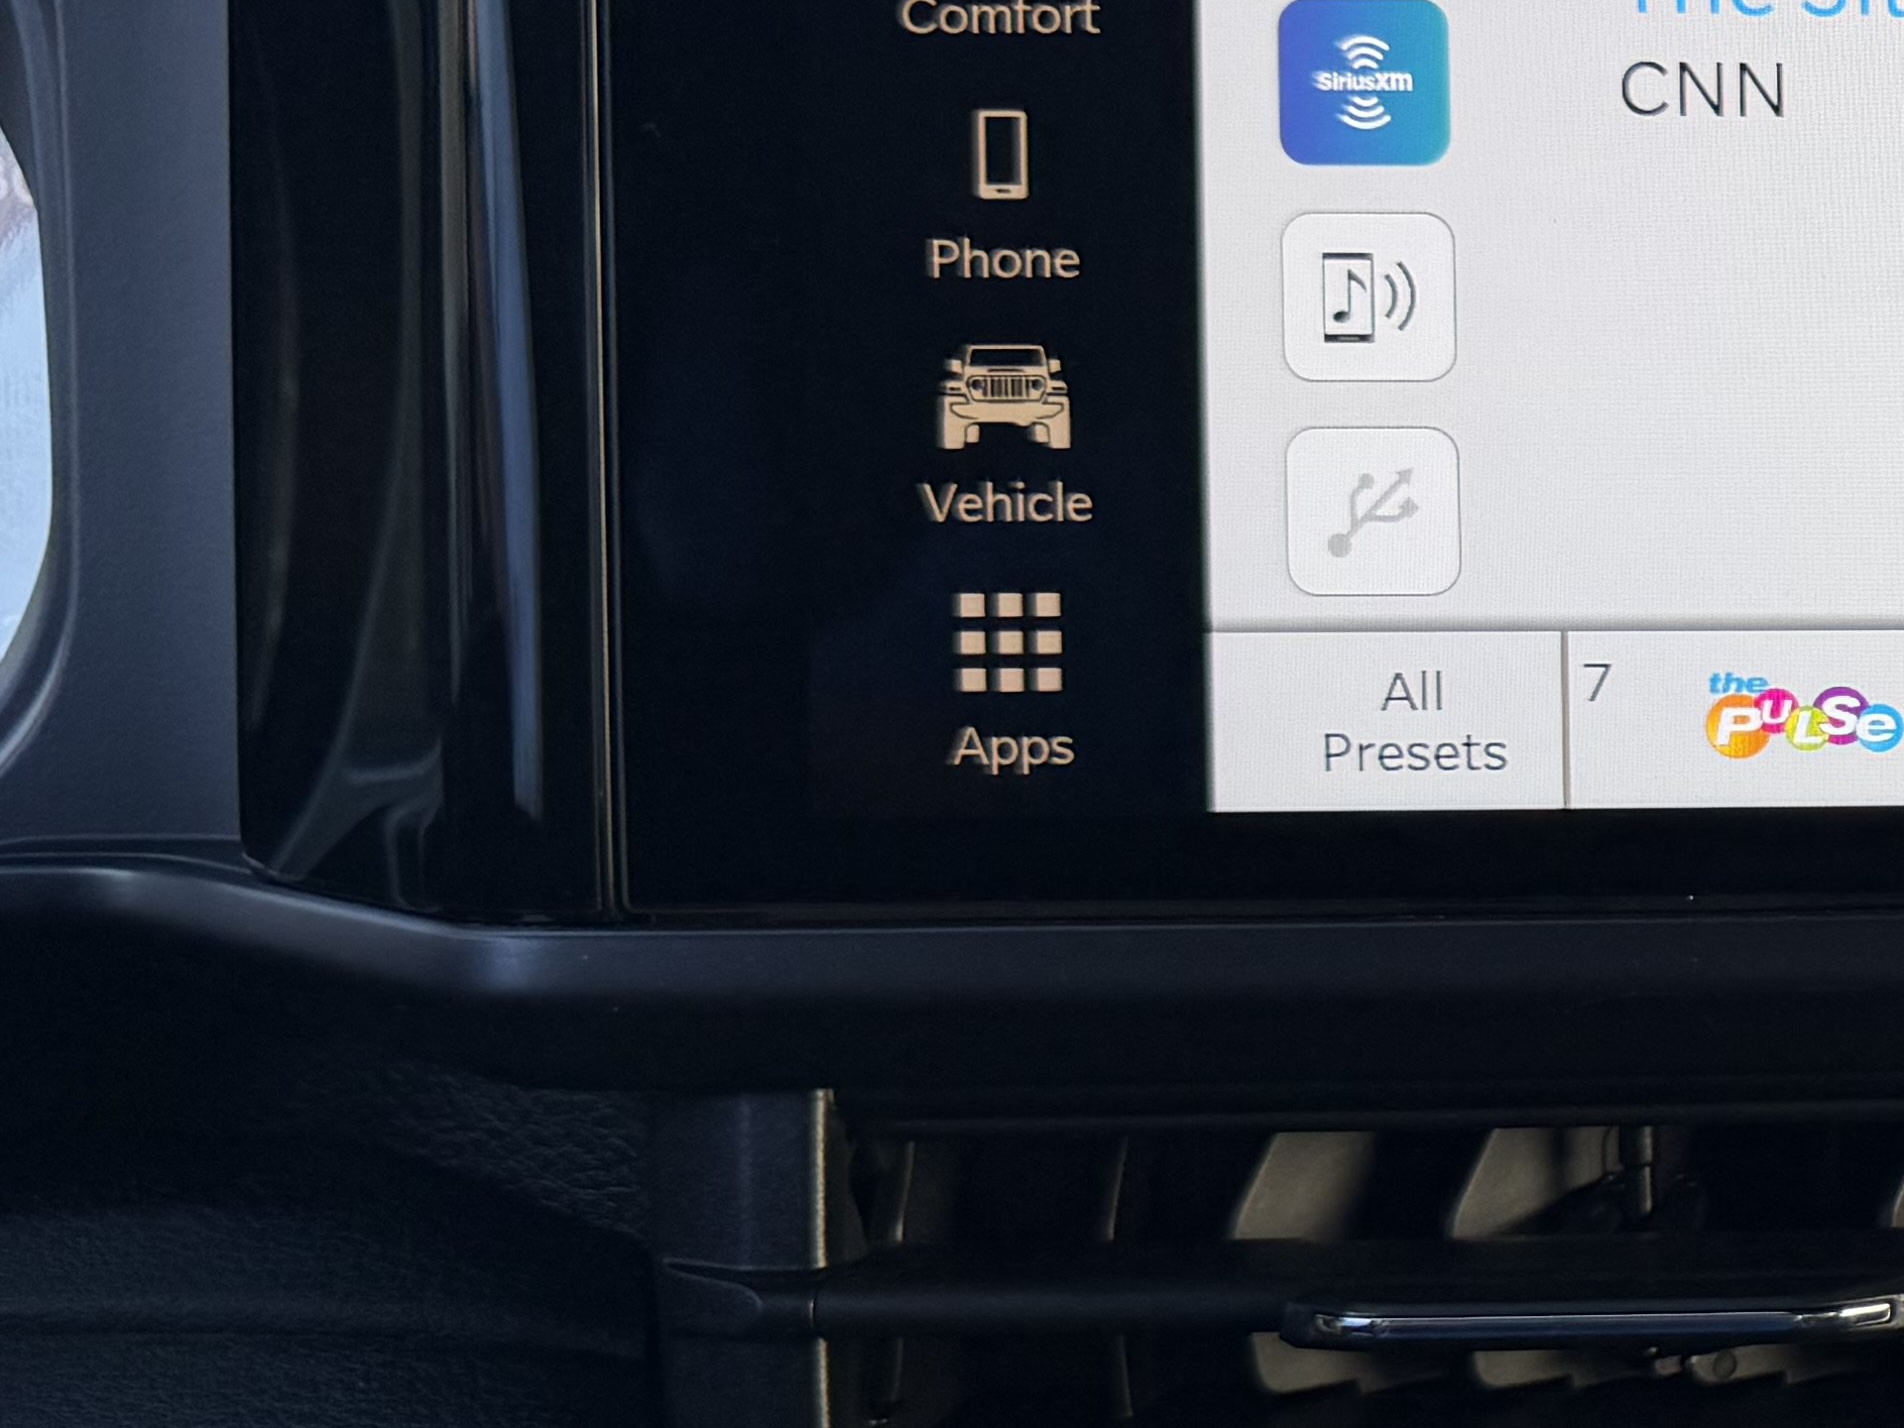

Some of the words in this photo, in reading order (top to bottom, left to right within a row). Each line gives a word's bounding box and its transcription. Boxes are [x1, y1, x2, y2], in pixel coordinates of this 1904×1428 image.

[1621, 60, 1784, 117] CNN
[927, 237, 1080, 279] Phone
[919, 482, 1093, 524] Vehicle
[1380, 671, 1444, 712] All
[1584, 663, 1612, 702] 7
[1709, 672, 1769, 696] the
[949, 727, 1075, 775] Apps
[1323, 733, 1508, 772] Presets
